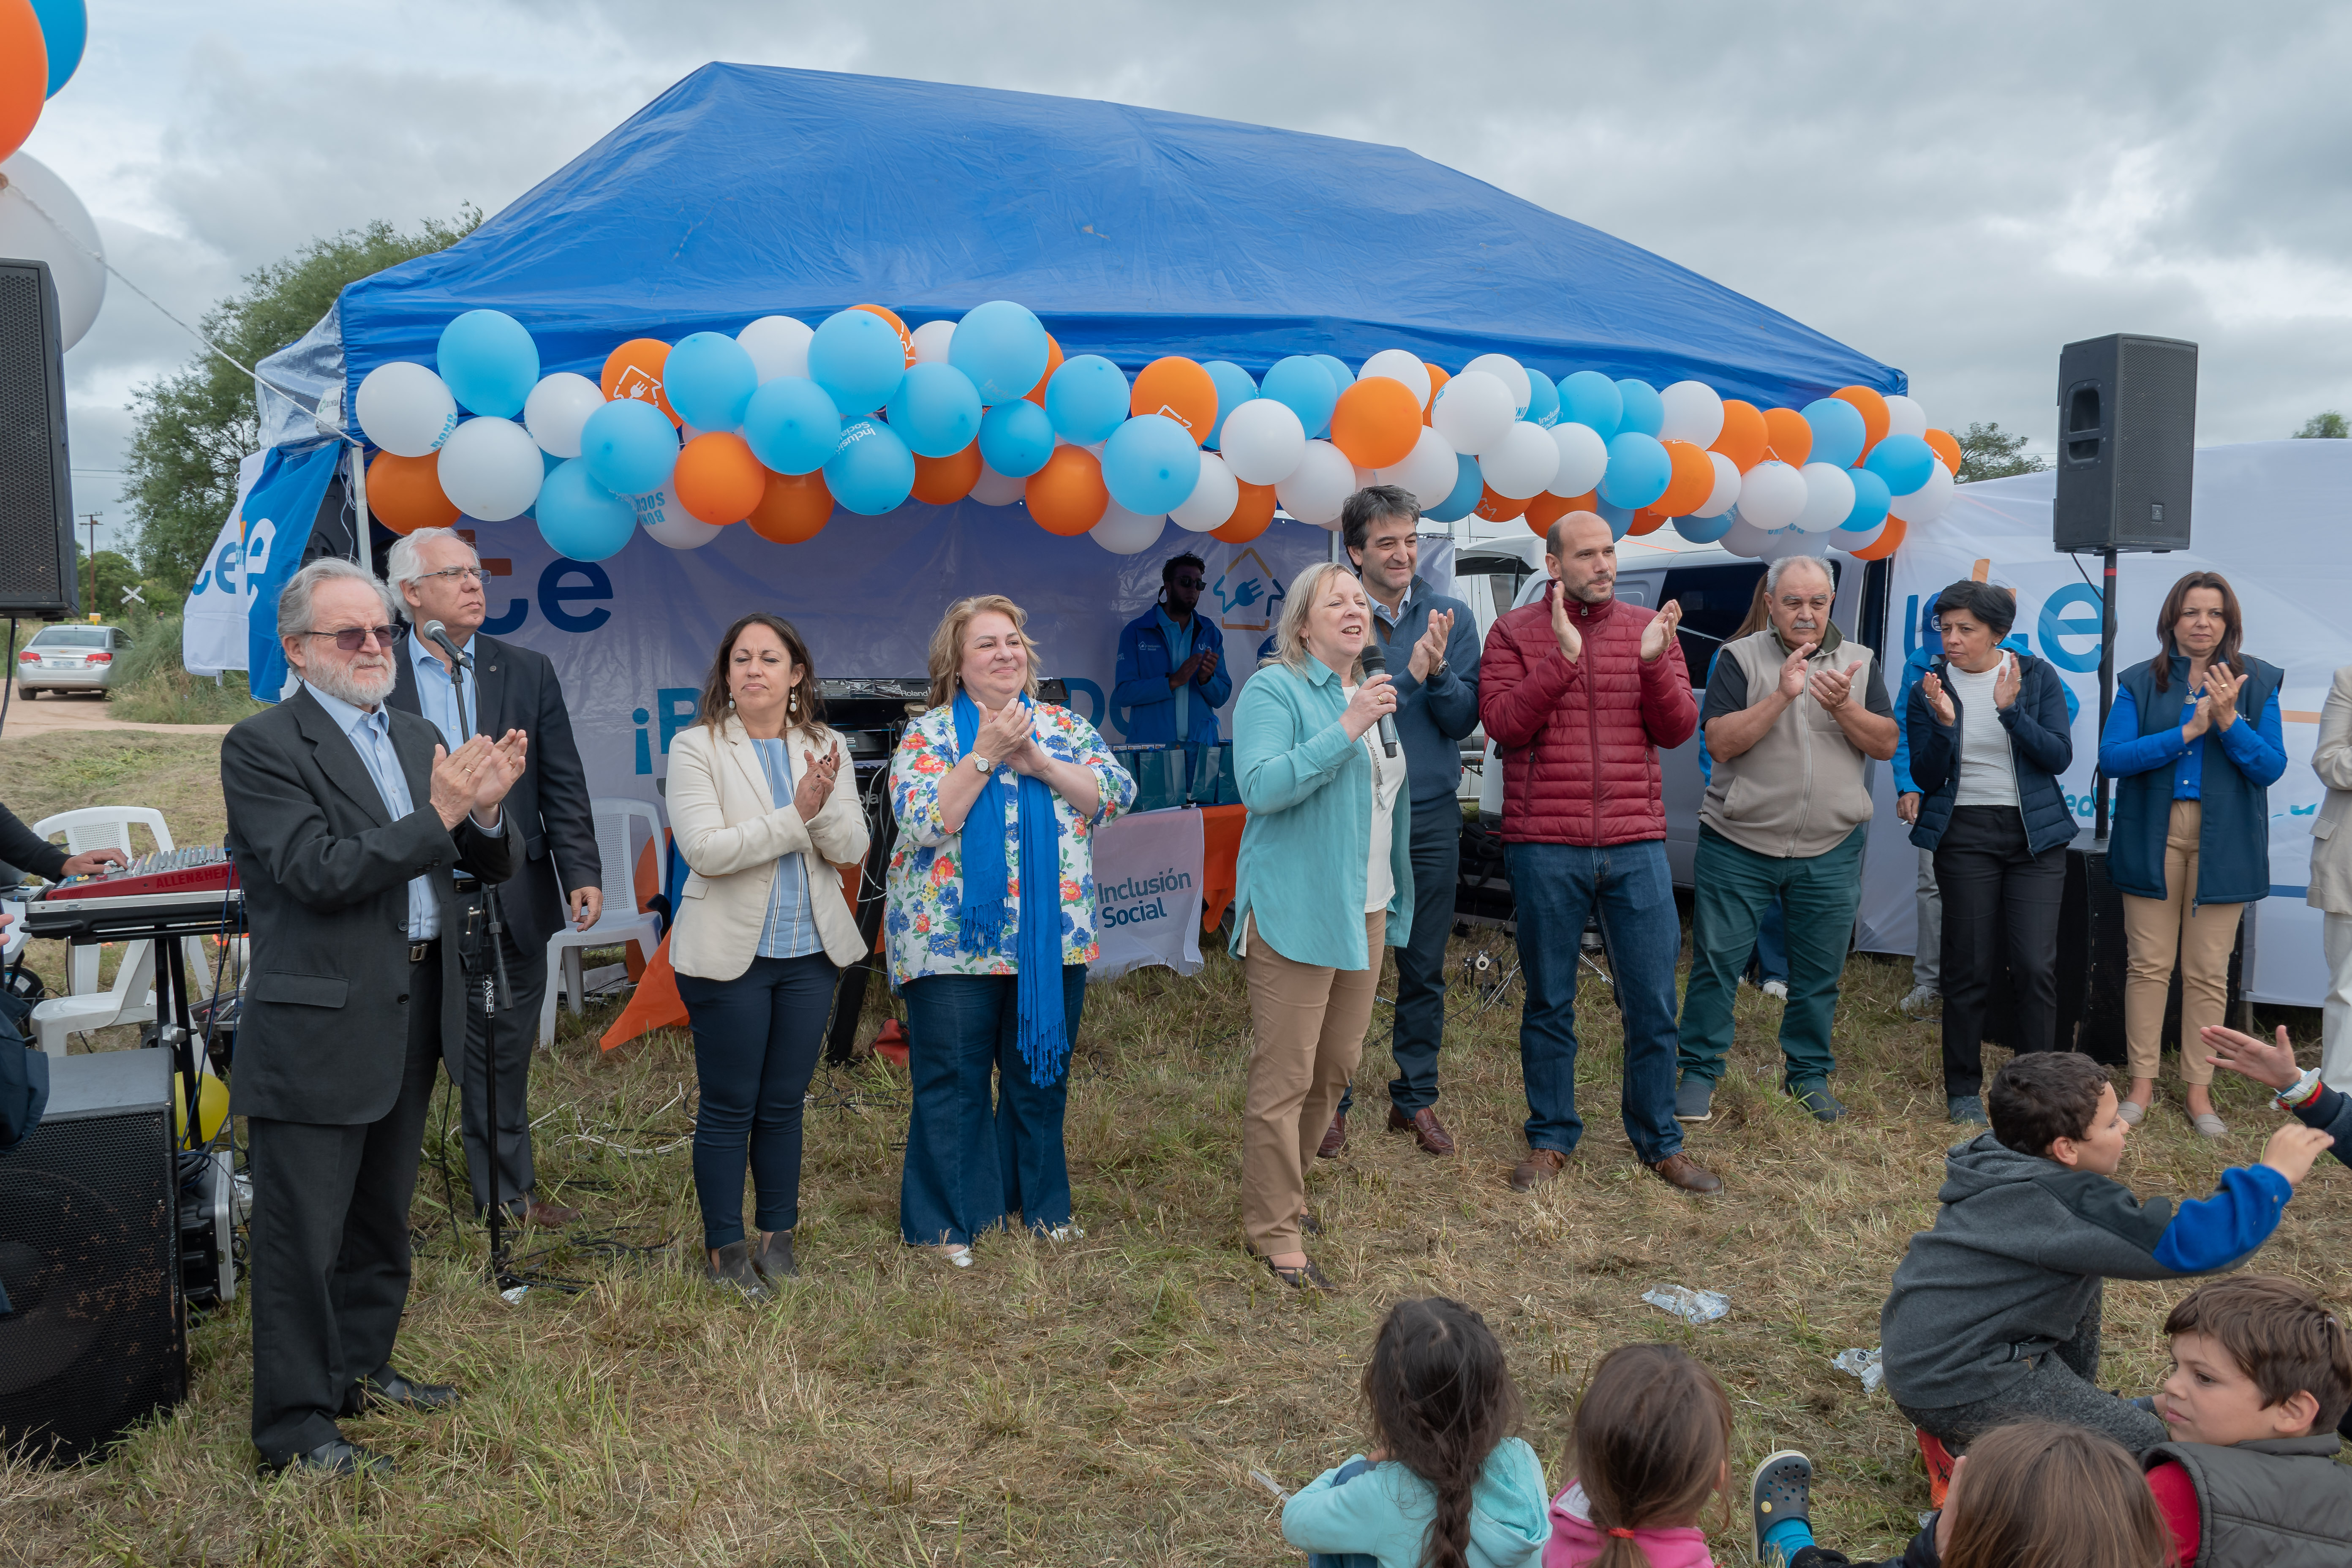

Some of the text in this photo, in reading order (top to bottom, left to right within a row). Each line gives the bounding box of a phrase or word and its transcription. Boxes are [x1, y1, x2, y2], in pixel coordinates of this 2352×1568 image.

[430, 413, 453, 448] BONO
[1097, 867, 1192, 904] Inclusión
[1102, 897, 1168, 928] Social
